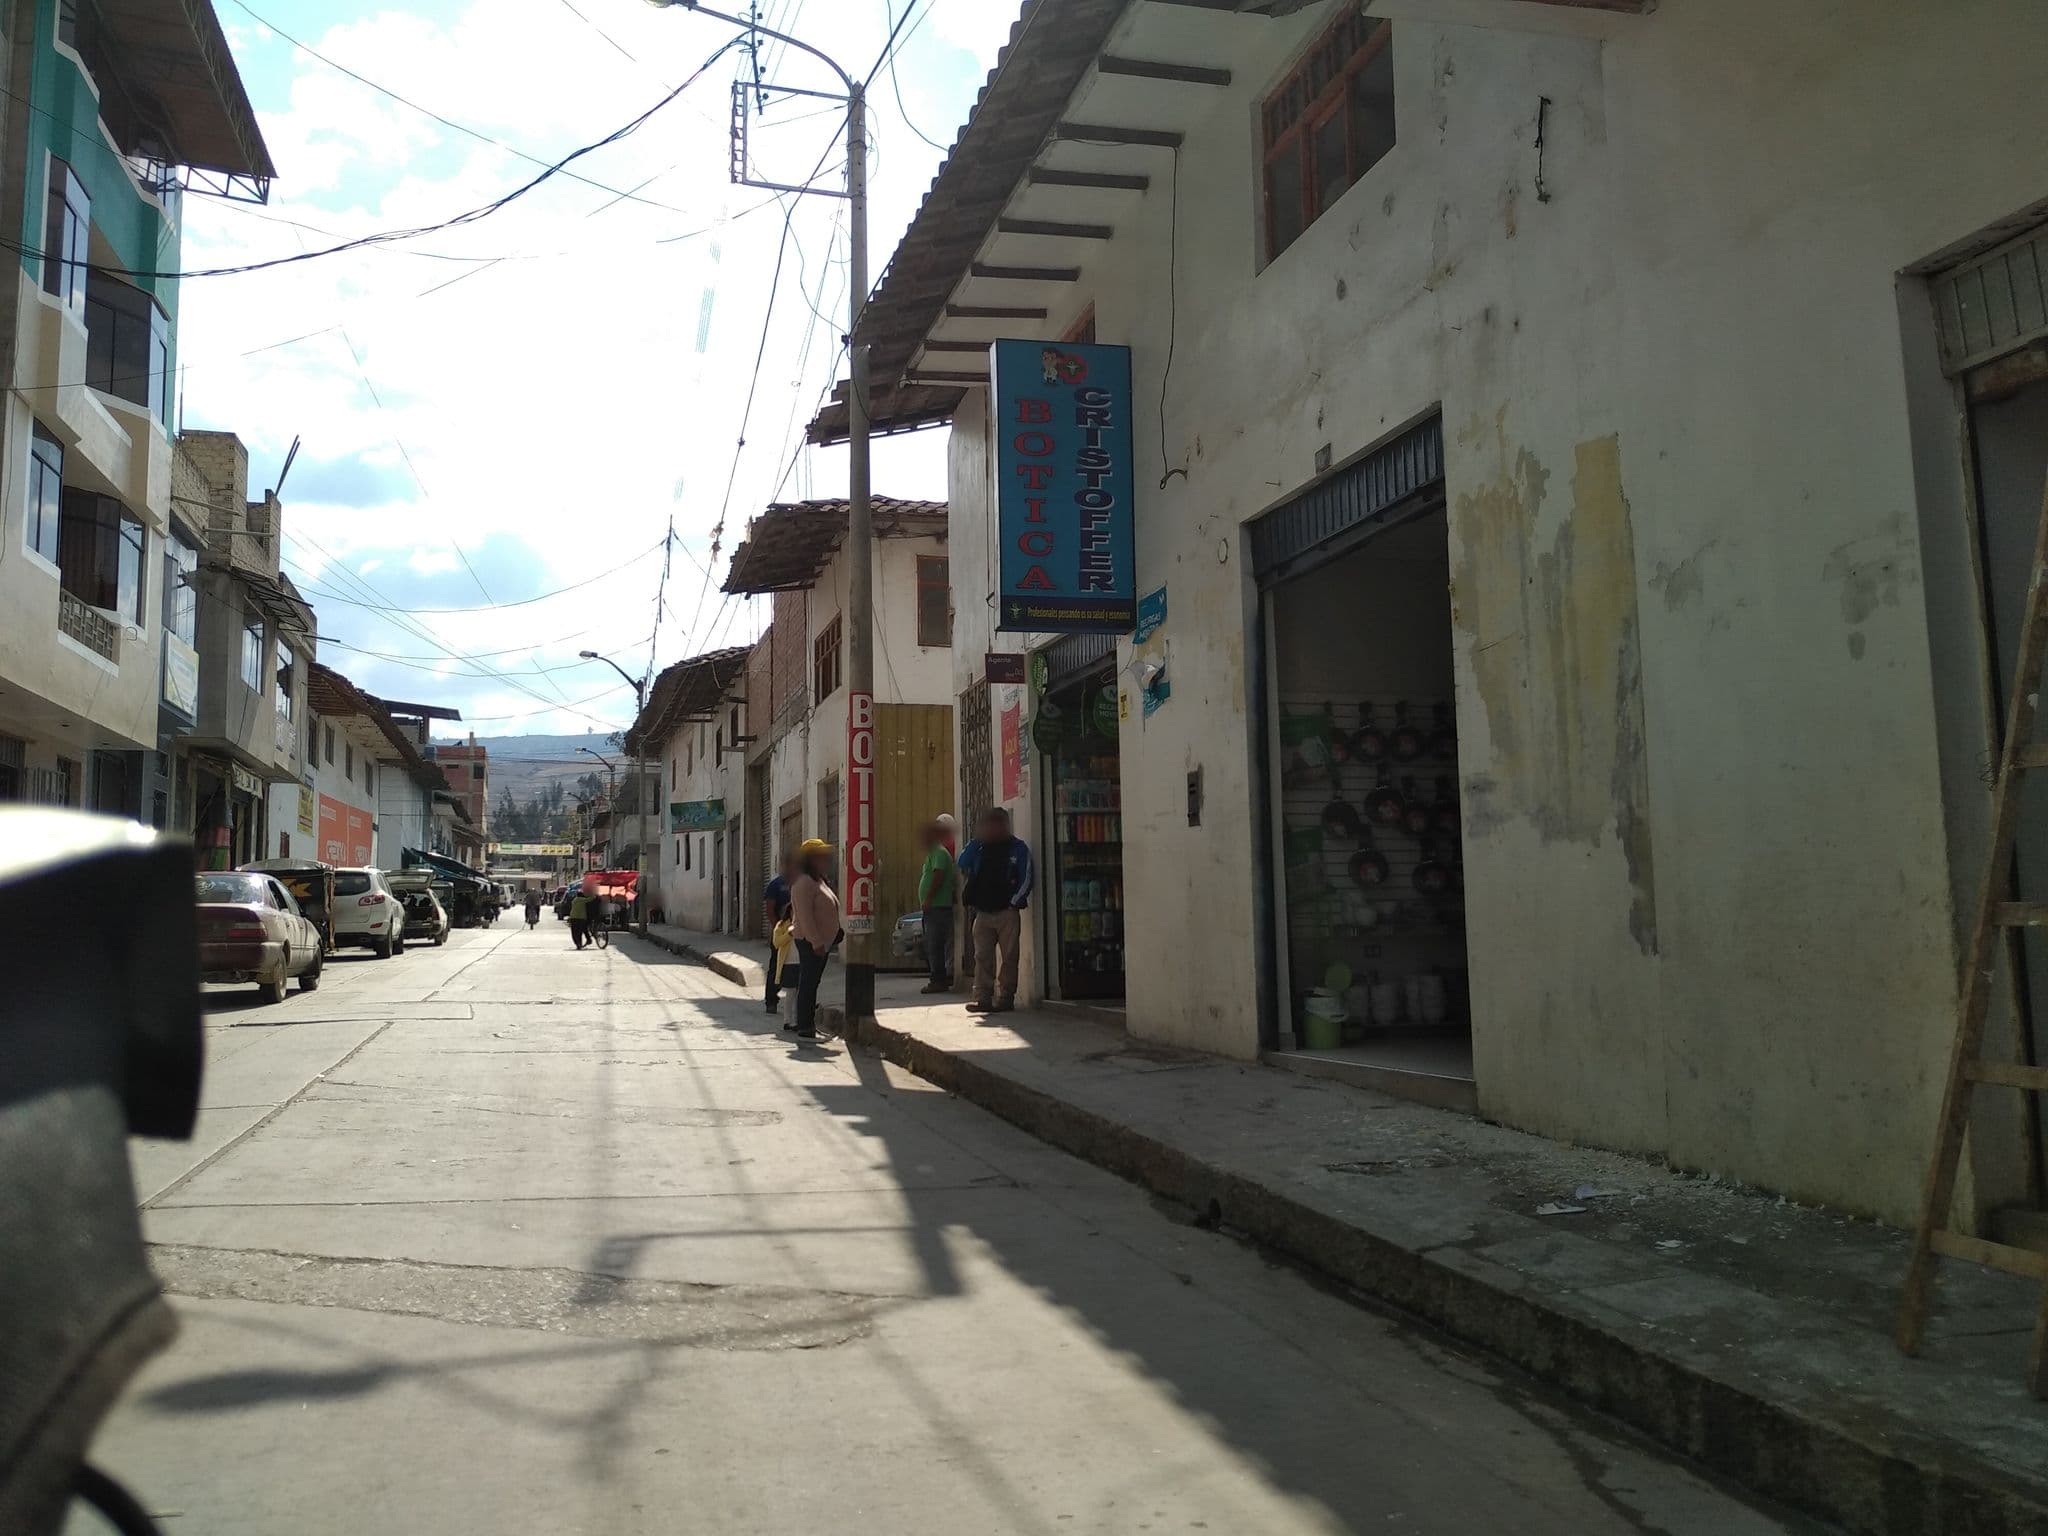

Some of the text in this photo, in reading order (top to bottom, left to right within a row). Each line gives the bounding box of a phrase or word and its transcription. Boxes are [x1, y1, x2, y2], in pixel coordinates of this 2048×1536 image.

[1014, 398, 1056, 590] BOTICA
[1074, 387, 1118, 593] CRISTOFFER
[852, 694, 873, 912] BOTICA
